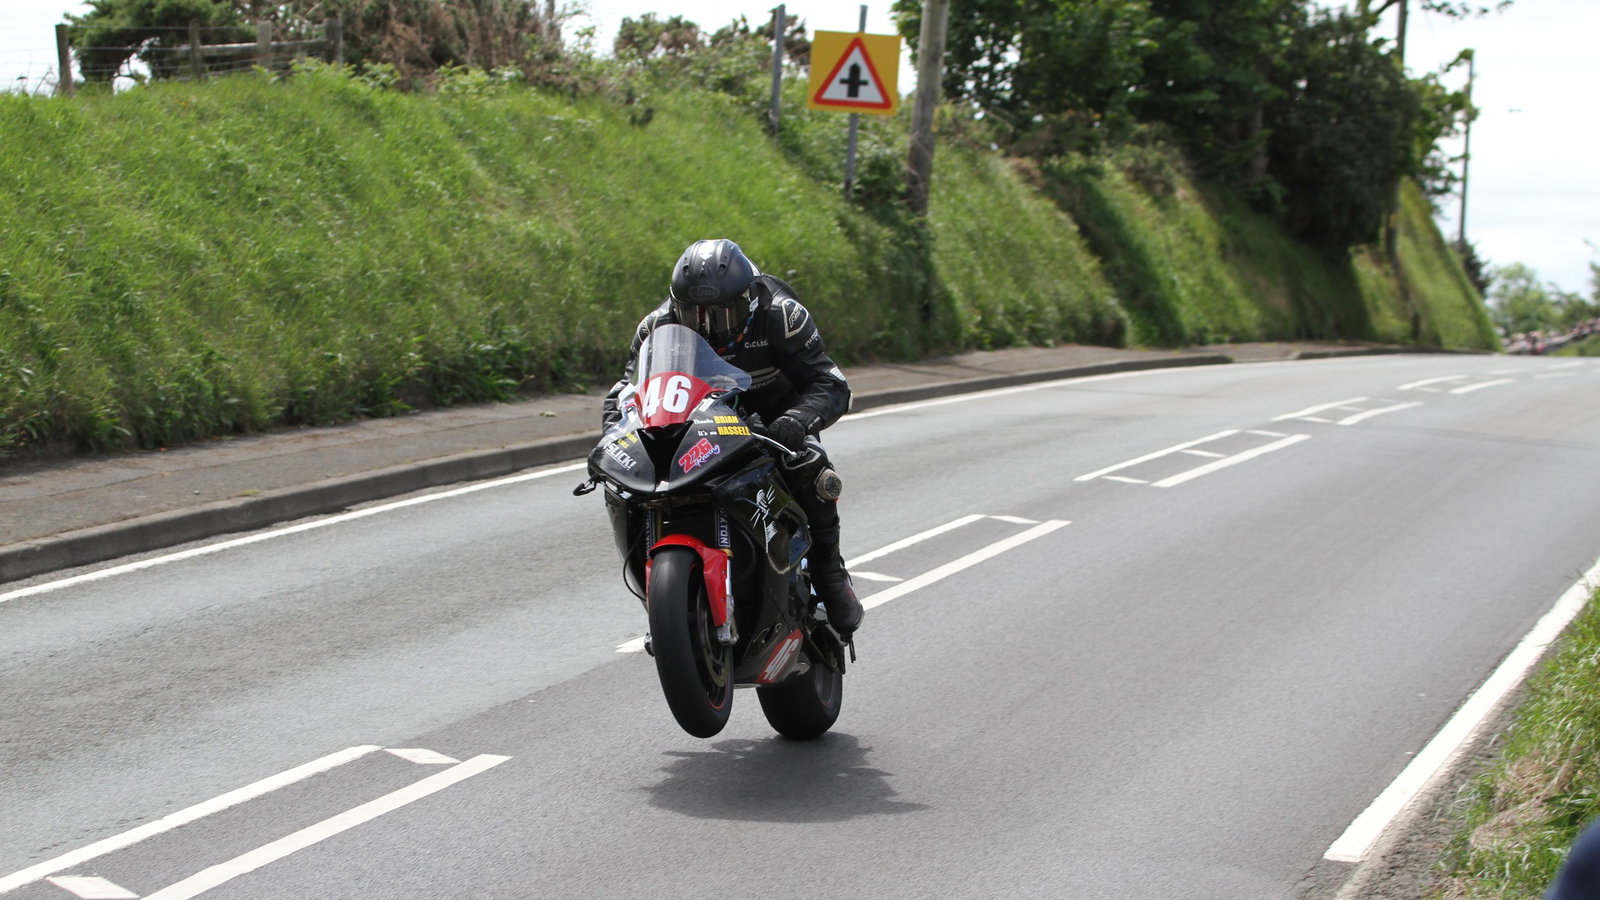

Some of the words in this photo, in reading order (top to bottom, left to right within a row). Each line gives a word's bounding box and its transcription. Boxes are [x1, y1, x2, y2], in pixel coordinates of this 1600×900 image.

[642, 375, 692, 418] 46
[713, 415, 739, 424] BRIAN
[716, 426, 751, 436] HASSELL
